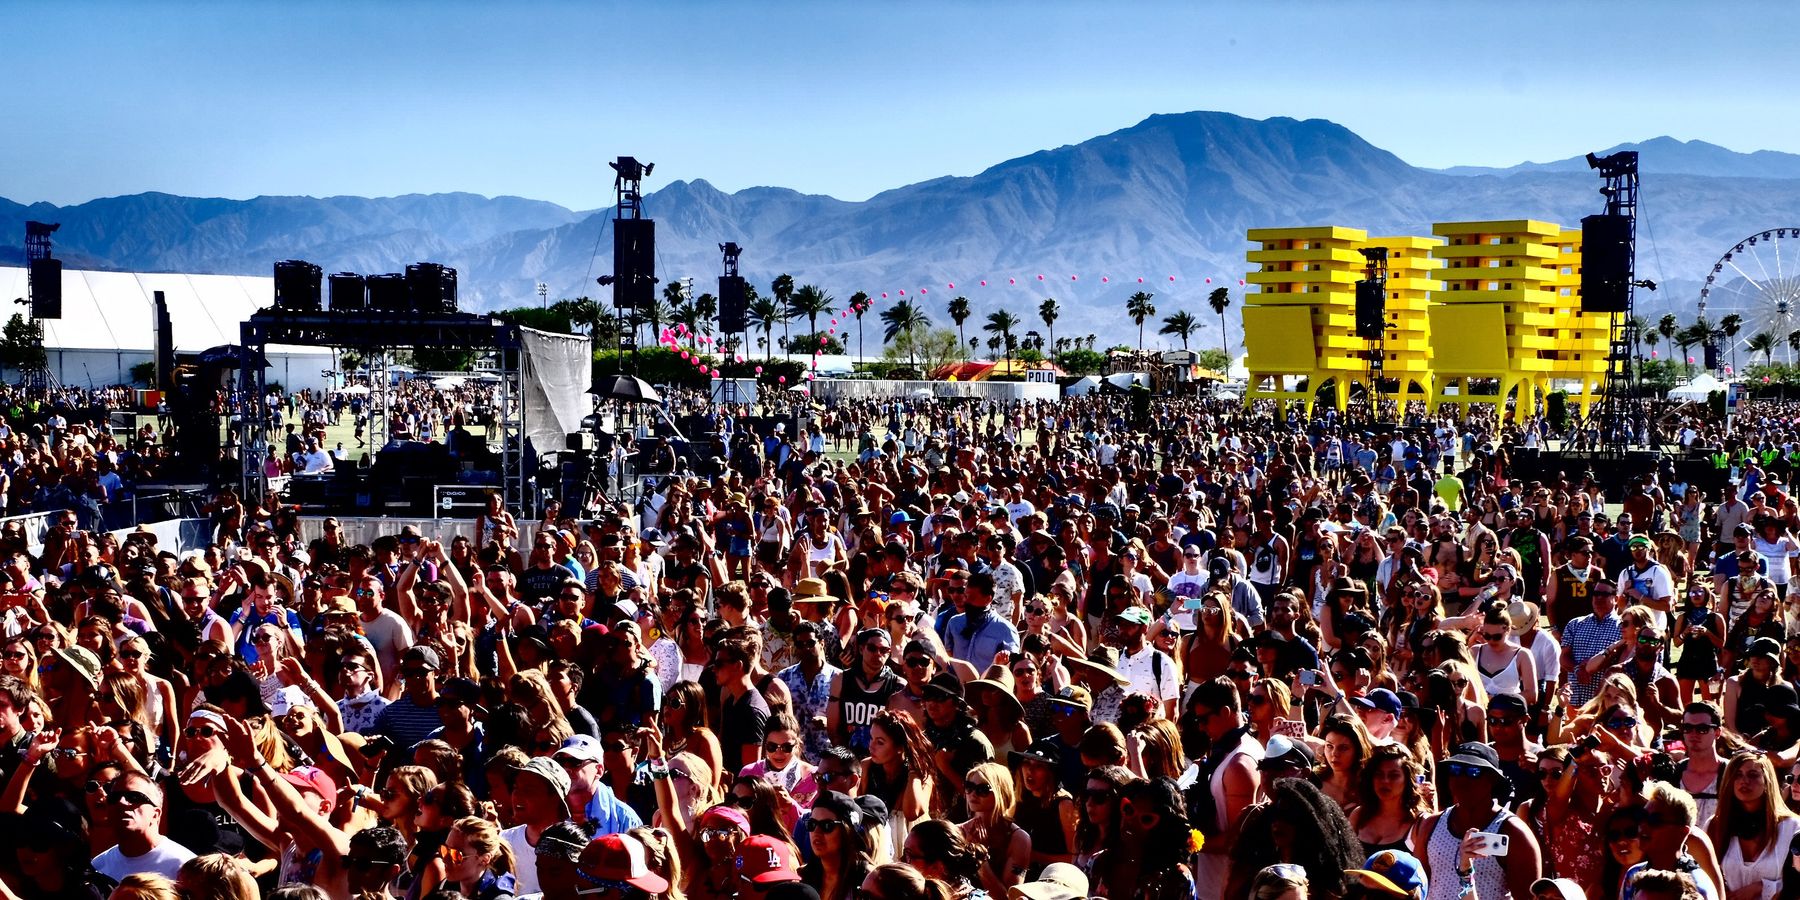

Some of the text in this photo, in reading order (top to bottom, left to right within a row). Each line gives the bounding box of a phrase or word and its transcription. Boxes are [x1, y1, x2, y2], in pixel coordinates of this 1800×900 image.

[1616, 345, 1628, 354] B1
[1028, 371, 1054, 383] POLO
[1571, 582, 1587, 597] 13
[766, 847, 782, 868] LA
